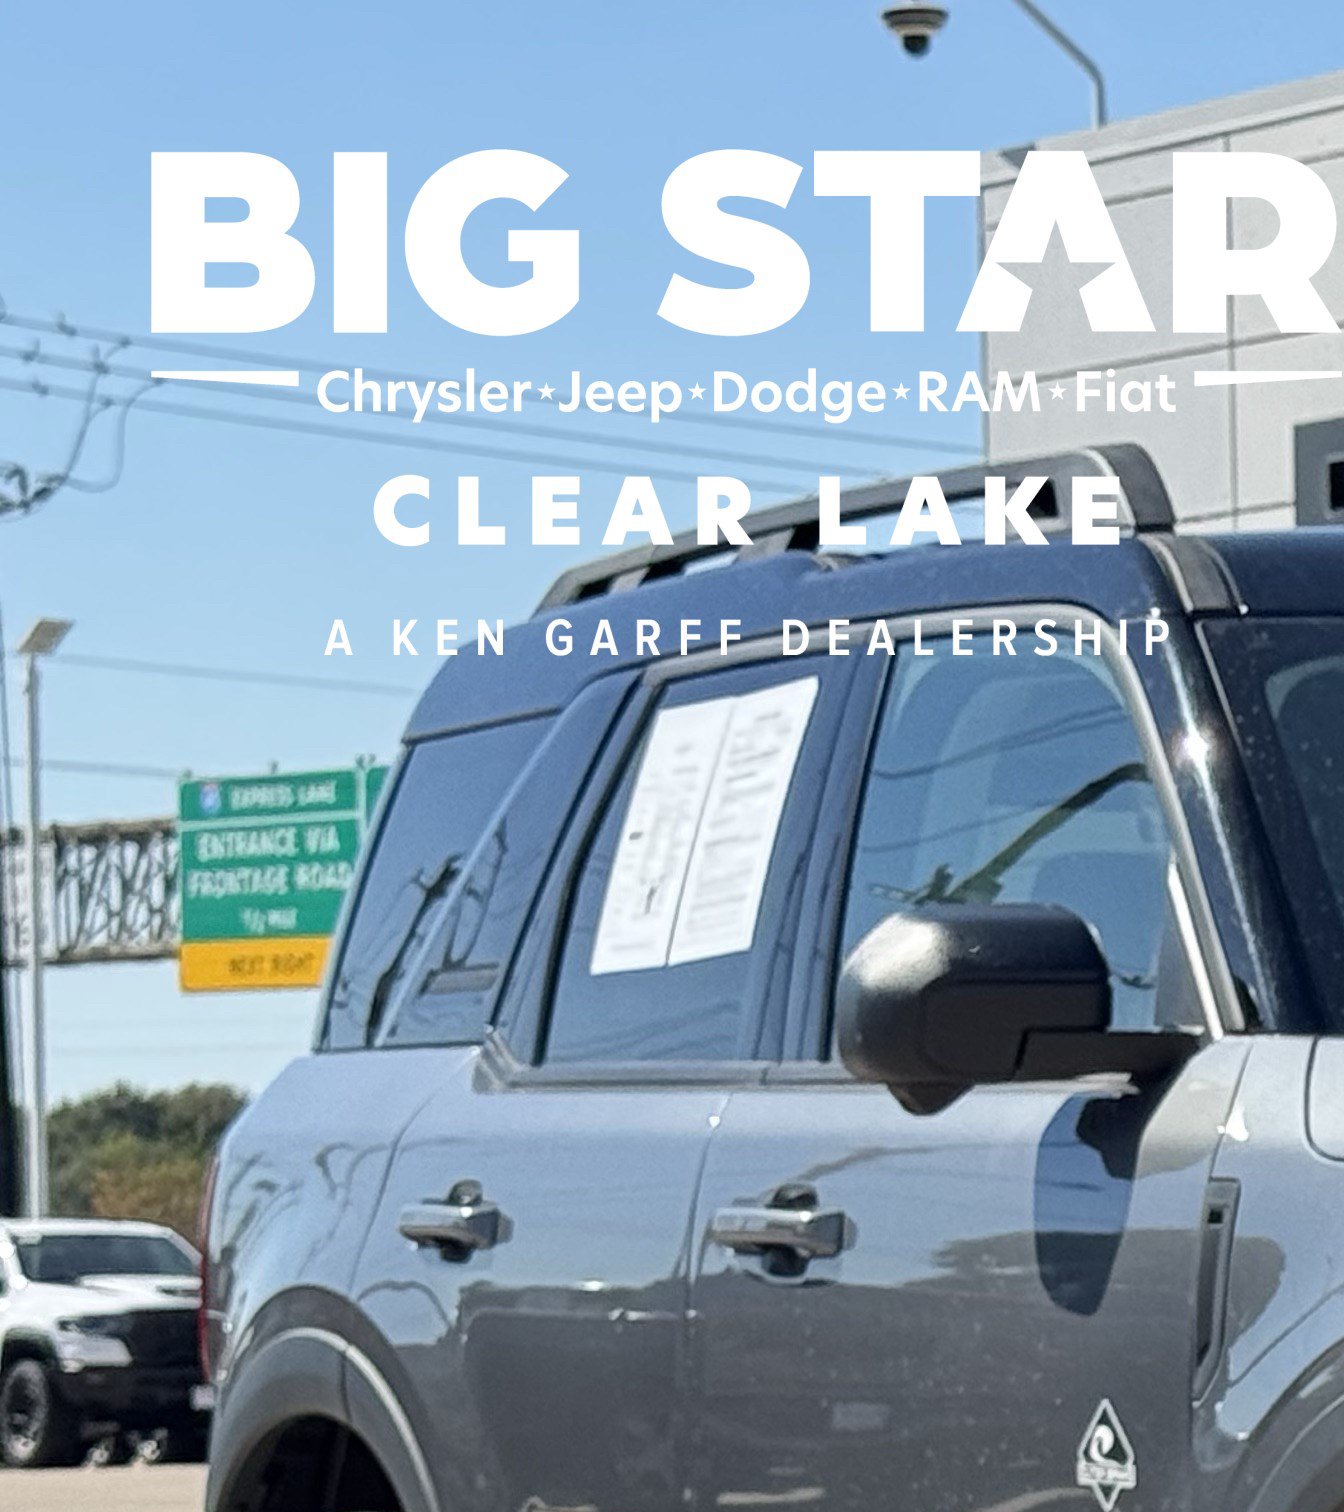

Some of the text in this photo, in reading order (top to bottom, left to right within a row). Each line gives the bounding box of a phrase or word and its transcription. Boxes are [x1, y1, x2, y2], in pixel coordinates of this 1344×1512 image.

[197, 826, 341, 862] ENTRANCE VIA
[188, 864, 290, 898] FRONTAGE
